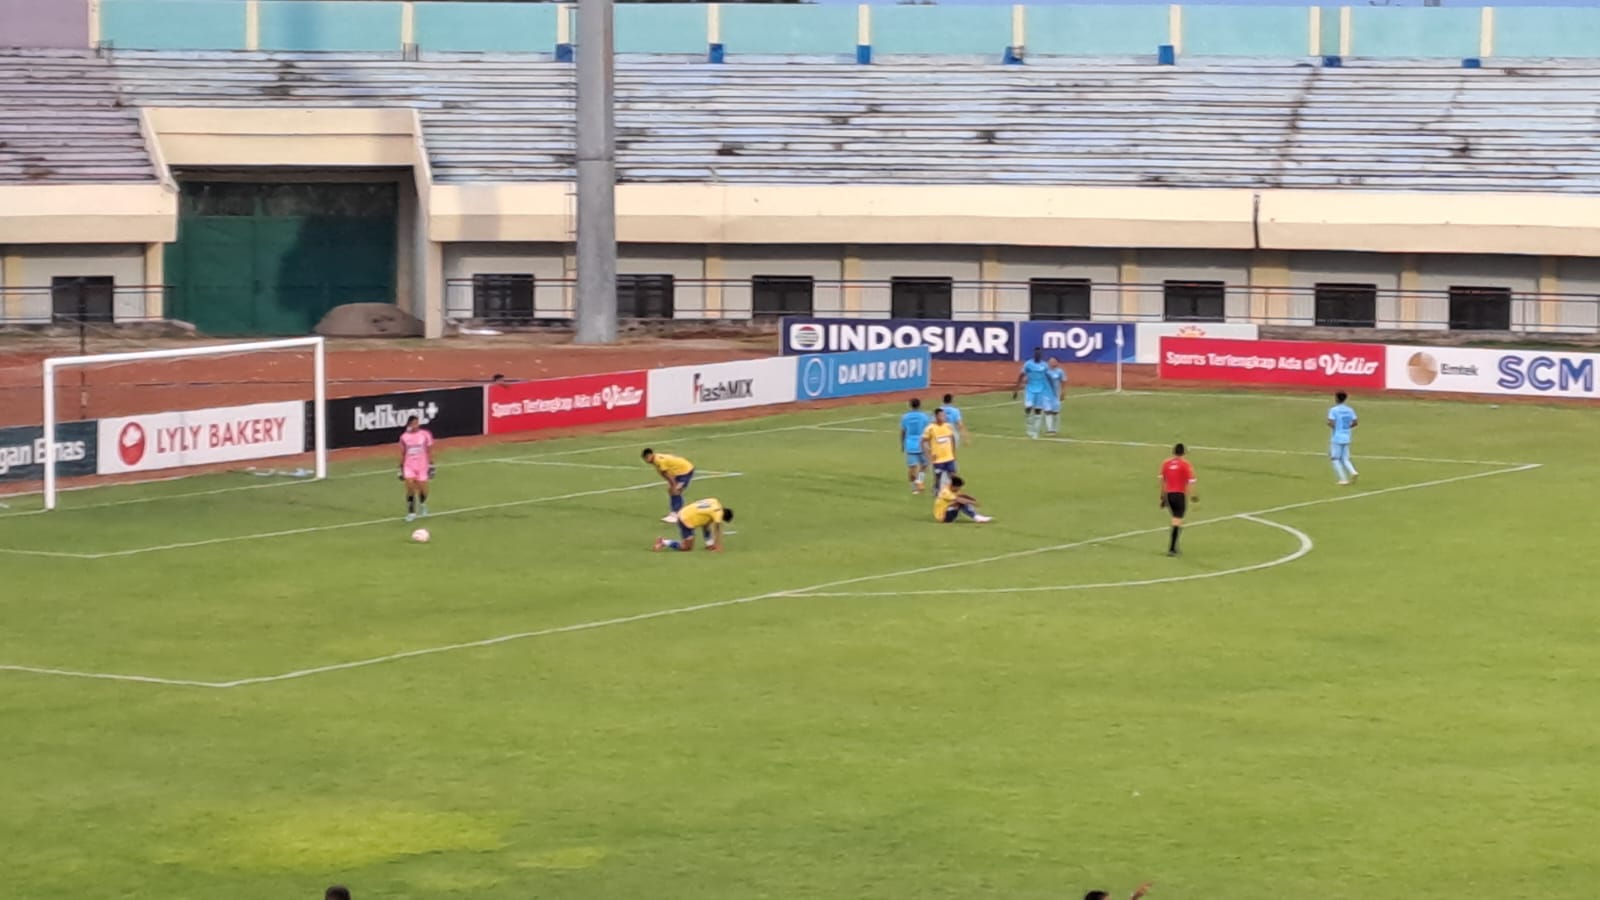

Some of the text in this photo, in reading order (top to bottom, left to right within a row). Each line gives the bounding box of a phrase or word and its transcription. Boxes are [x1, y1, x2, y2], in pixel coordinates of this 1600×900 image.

[829, 325, 1009, 354] INDOSIAR
[838, 357, 923, 384] DAPUR KOPI
[1166, 352, 1206, 367] Sports
[1319, 353, 1379, 376] Vidio
[1497, 355, 1594, 392] SCM
[156, 417, 287, 454] LYLY BAKERY
